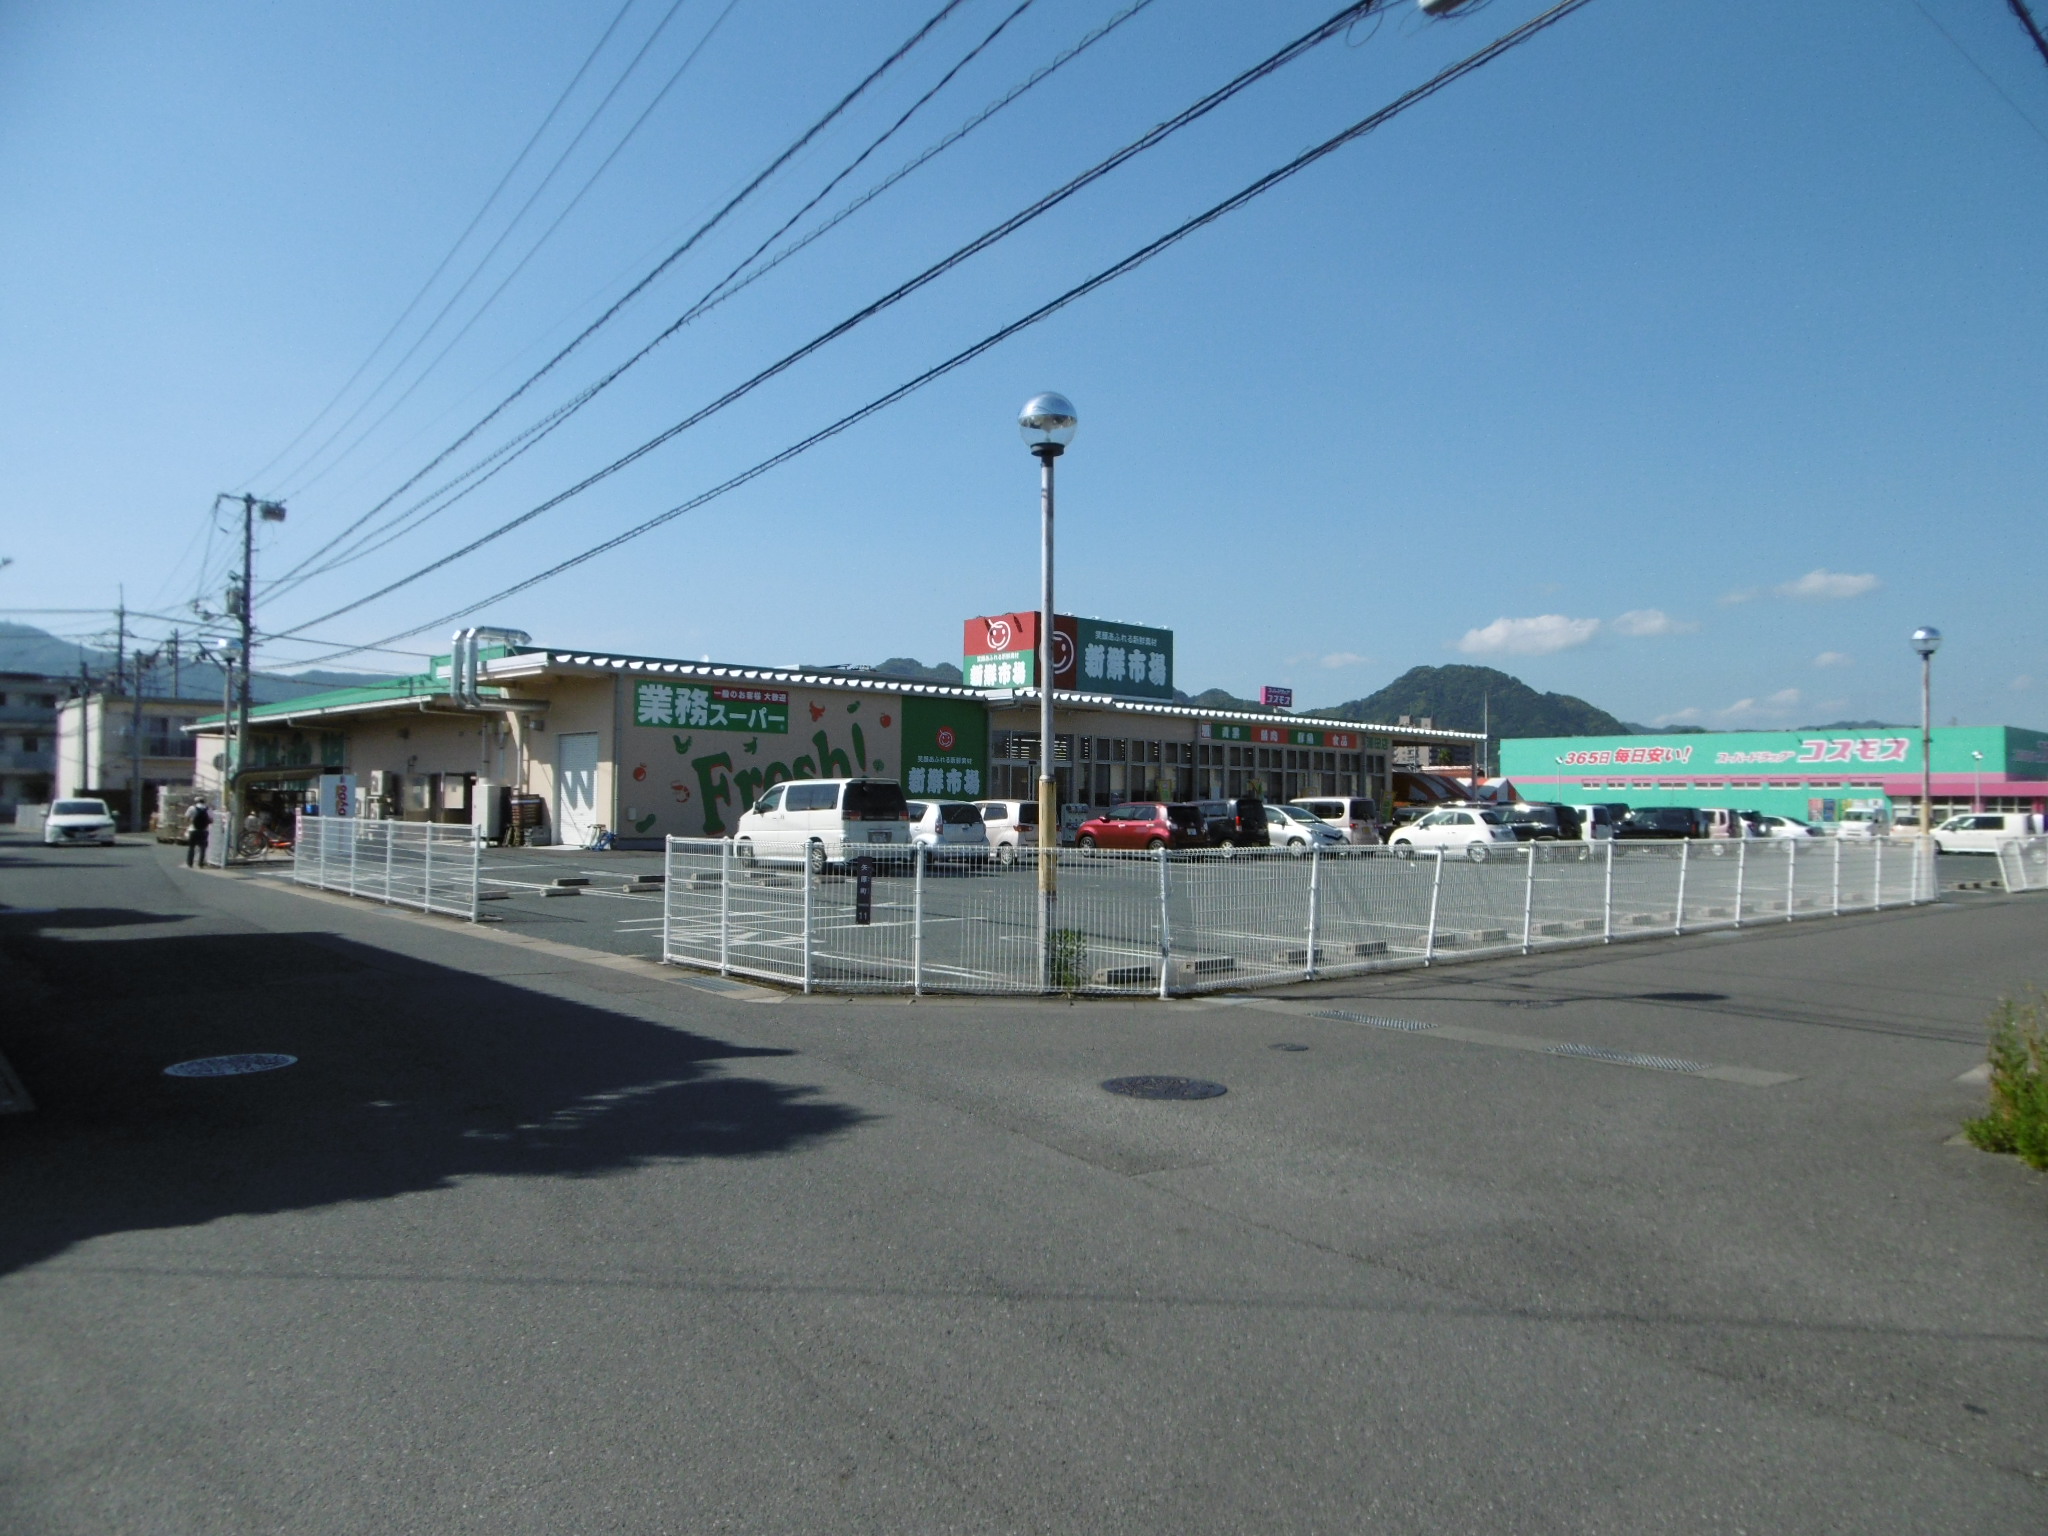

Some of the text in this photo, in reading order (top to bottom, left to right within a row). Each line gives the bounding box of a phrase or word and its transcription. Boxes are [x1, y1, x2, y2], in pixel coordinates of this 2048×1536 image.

[1085, 642, 1167, 686] 新鮮市場
[637, 683, 785, 729] 業務スーパー
[1267, 694, 1291, 705] コスモス
[1564, 751, 1611, 765] 365日
[1796, 737, 1909, 763] コスモス
[908, 766, 980, 796] 新鮮市場
